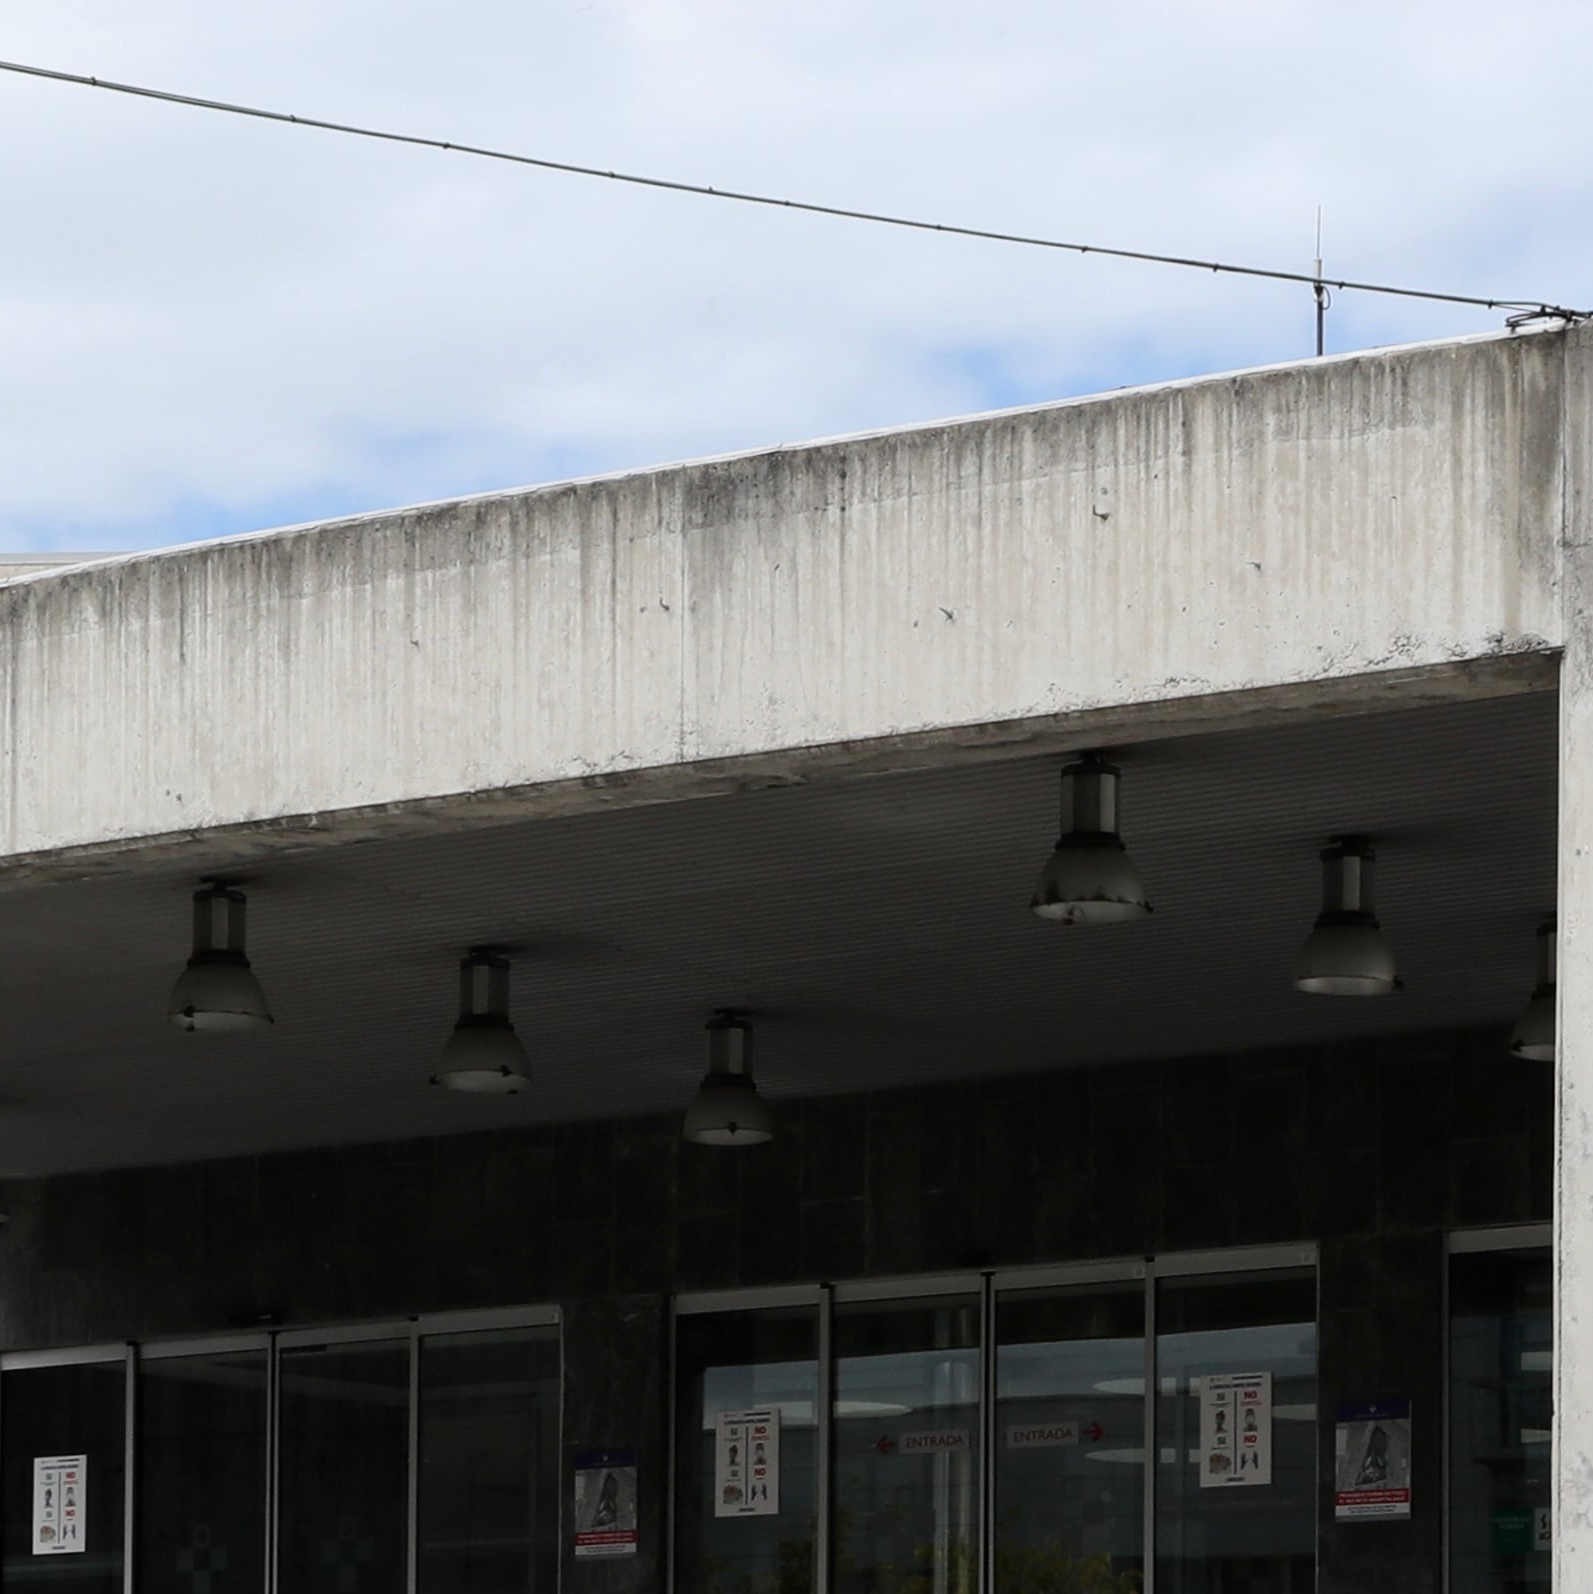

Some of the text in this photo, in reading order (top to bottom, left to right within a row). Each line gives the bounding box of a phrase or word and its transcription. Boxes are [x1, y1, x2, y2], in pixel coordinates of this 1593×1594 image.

[1244, 1391, 1257, 1399] NO
[754, 1426, 766, 1434] NO
[1014, 1428, 1072, 1442] ENTRADA
[1244, 1435, 1257, 1443] NO
[906, 1435, 965, 1449] ENTRADA
[754, 1468, 766, 1476] NO
